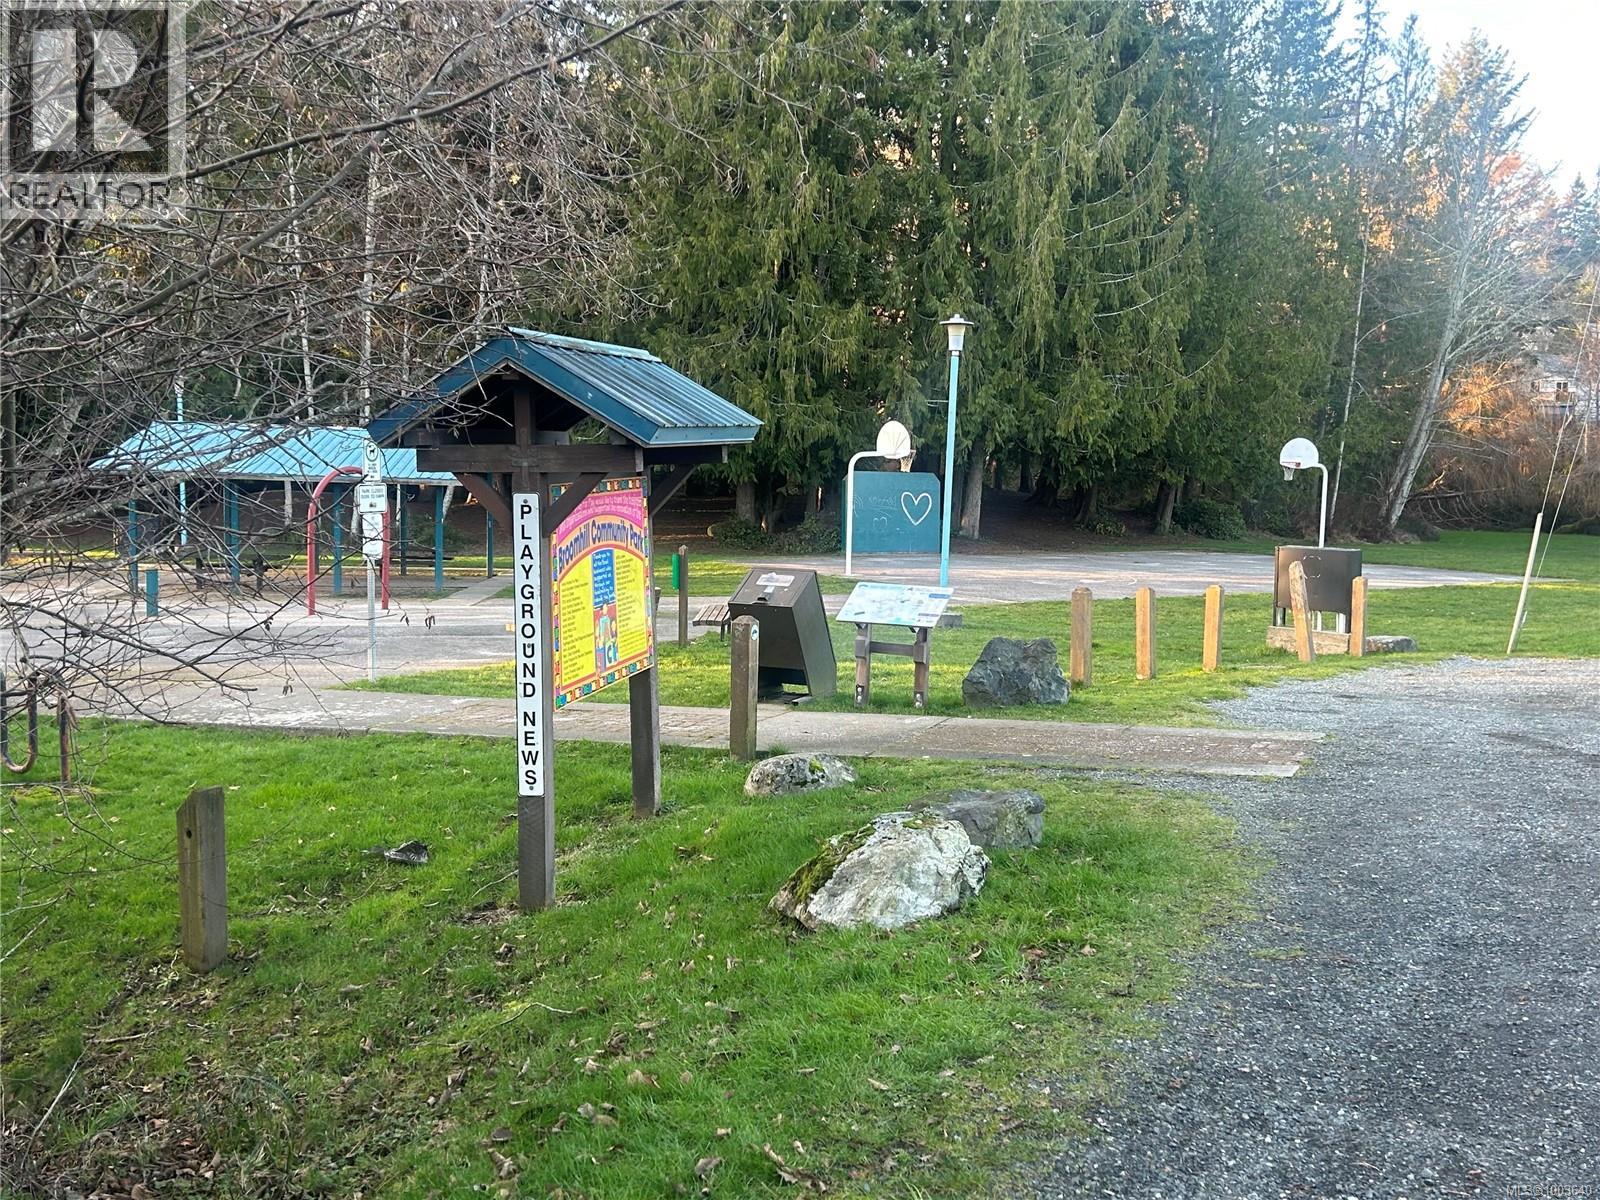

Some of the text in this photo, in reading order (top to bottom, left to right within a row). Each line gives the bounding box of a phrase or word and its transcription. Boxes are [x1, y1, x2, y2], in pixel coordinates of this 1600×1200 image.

[558, 520, 645, 575] Broomhill Community Park
[520, 504, 539, 786] PLAYGROUND NEWS
